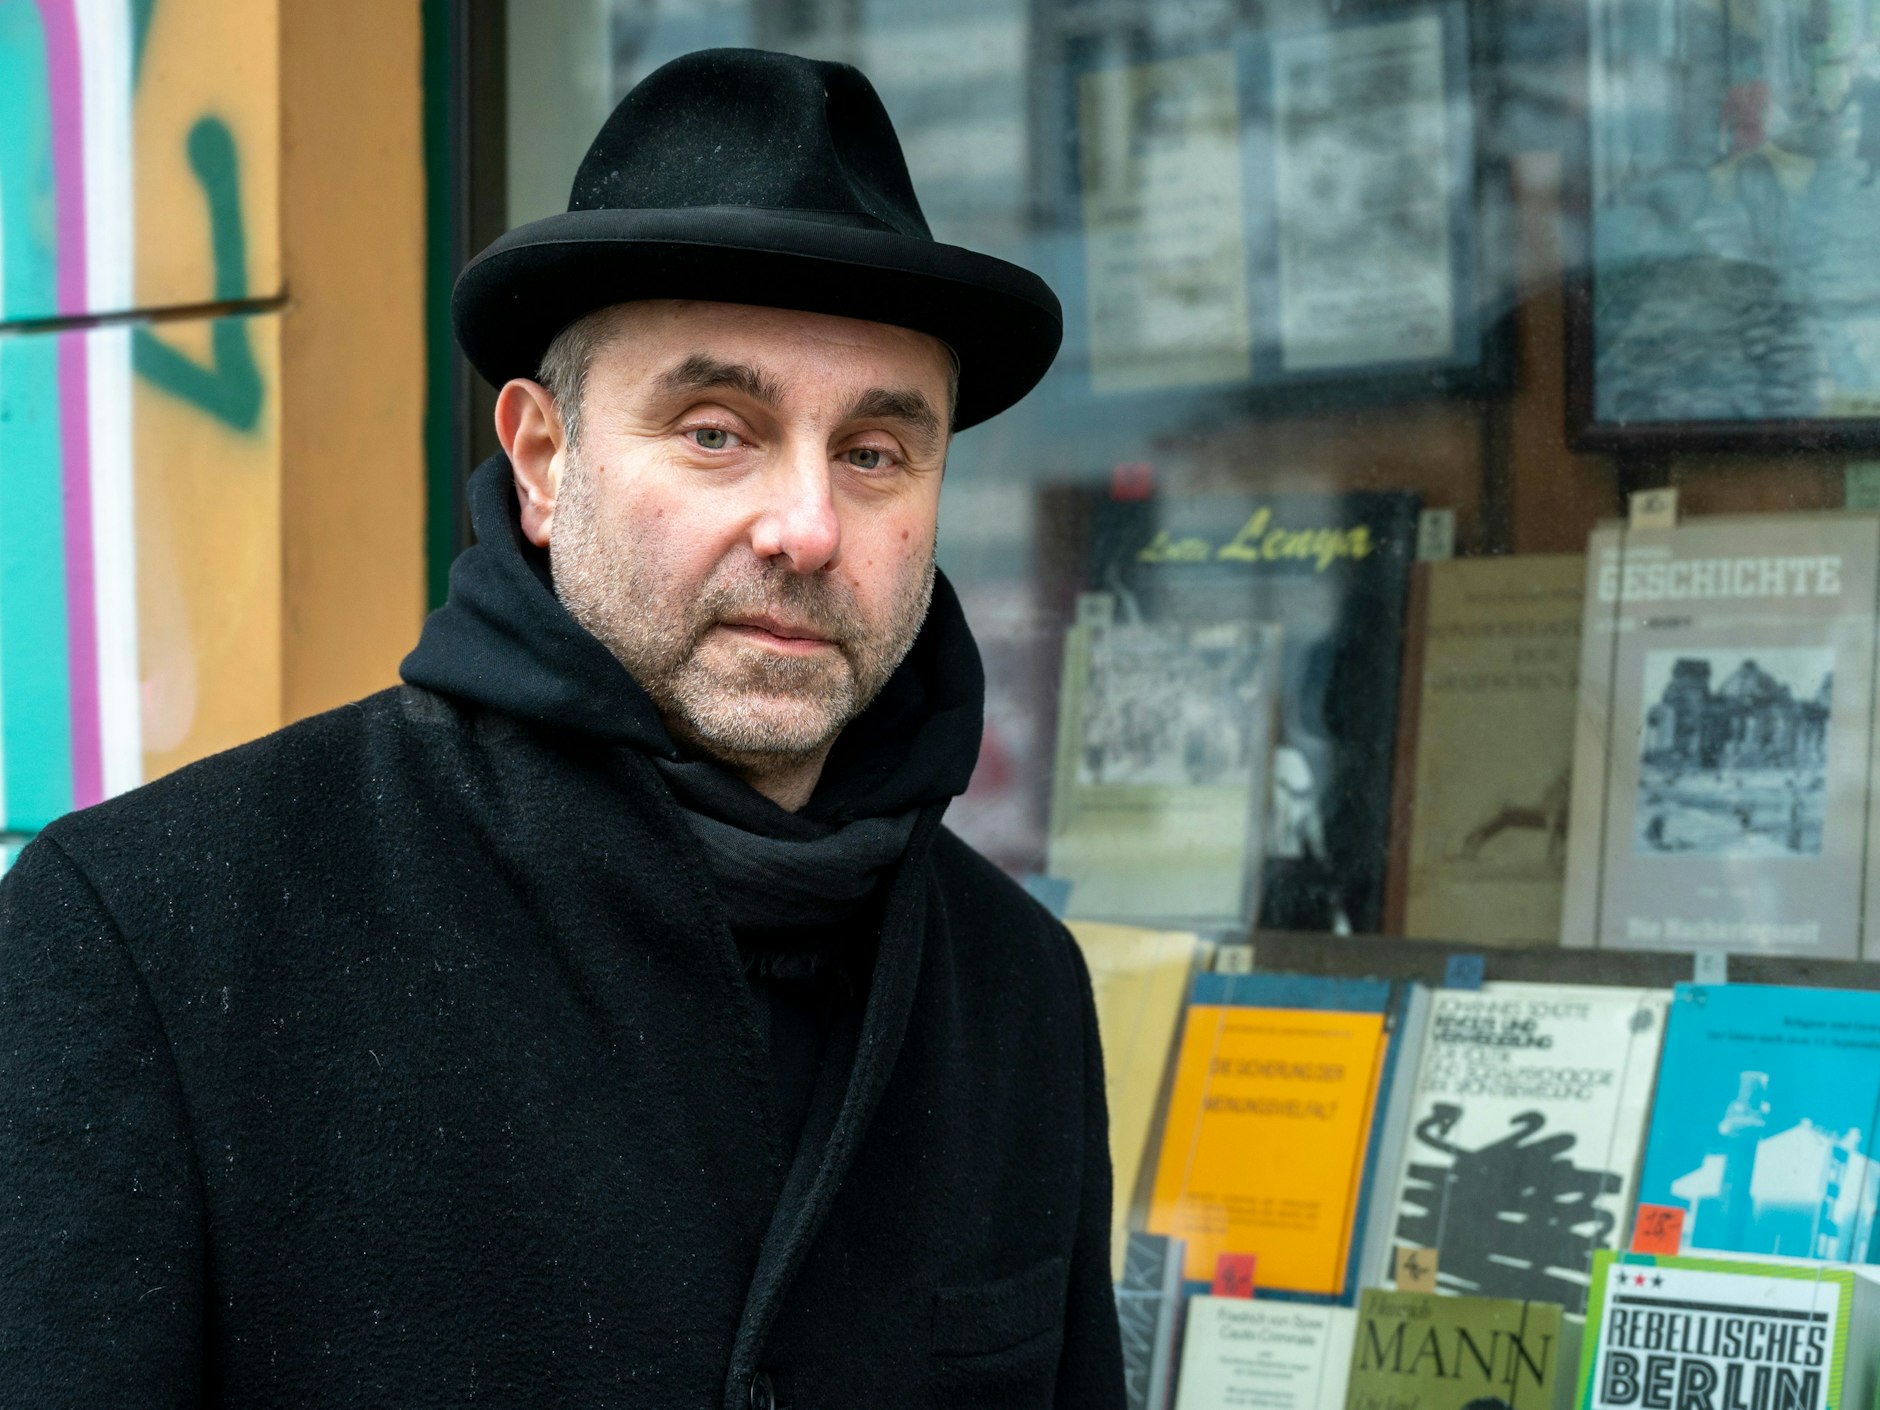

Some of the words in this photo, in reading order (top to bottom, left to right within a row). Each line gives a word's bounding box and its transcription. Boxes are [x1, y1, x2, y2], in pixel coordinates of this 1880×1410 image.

[1598, 555, 1843, 602] GESCHICHTE
[1360, 1318, 1554, 1388] MANN
[1607, 1307, 1828, 1367] REBELLISCHES
[1600, 1351, 1823, 1410] BERLIN
